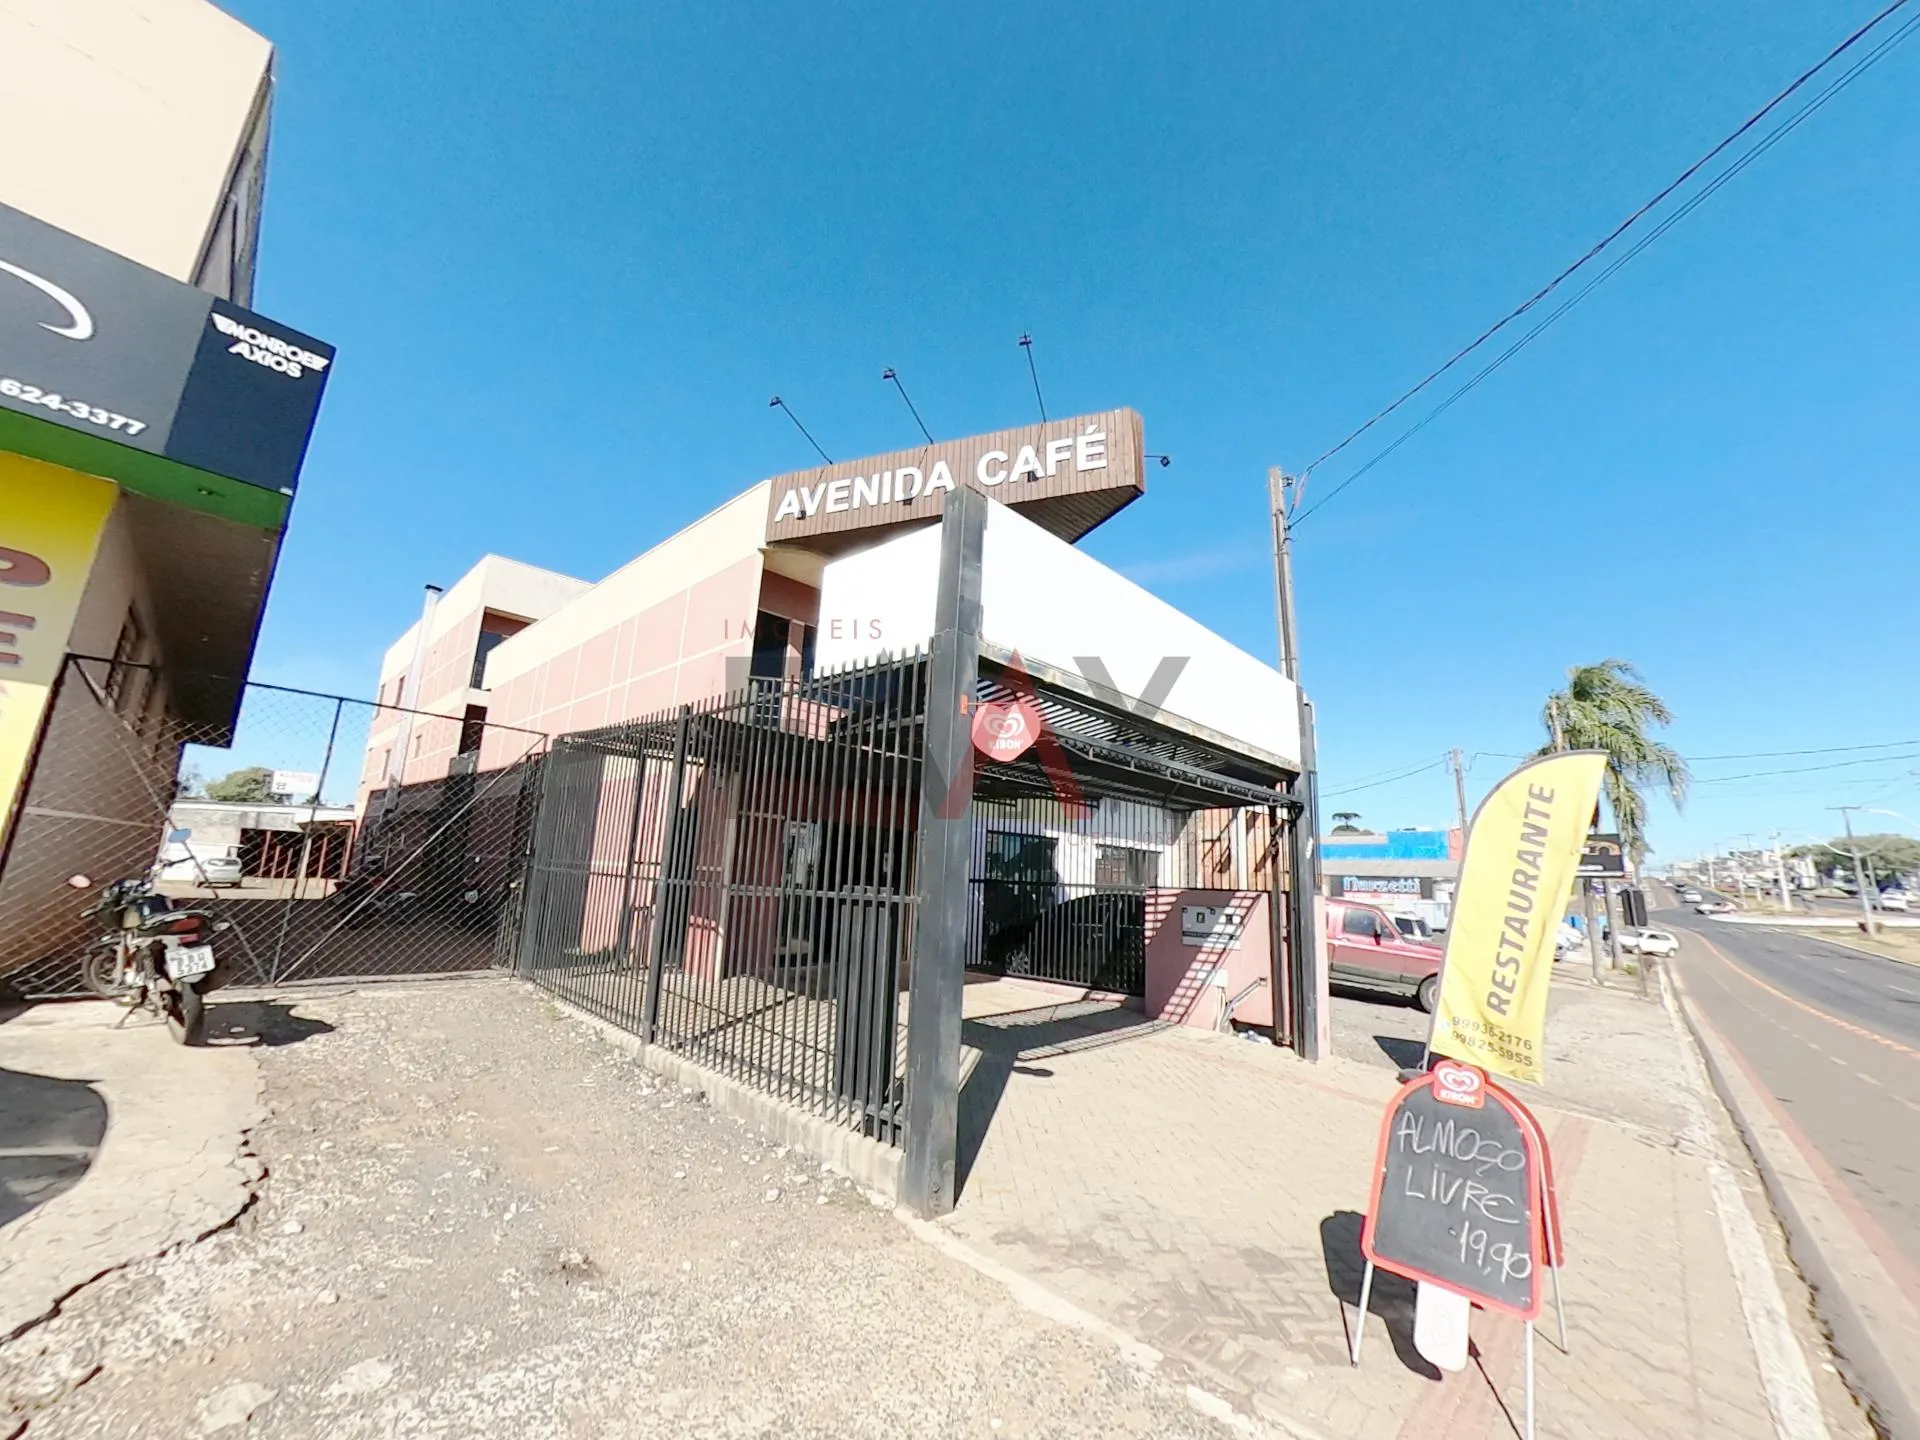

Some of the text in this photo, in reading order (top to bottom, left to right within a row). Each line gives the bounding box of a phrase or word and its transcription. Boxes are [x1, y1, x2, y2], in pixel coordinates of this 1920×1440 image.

[211, 312, 330, 371] MONROE
[228, 341, 304, 378] AXIOS
[0, 379, 147, 435] 624-3377
[774, 425, 1108, 522] AVENIDA CAFÉ
[1487, 782, 1555, 1016] RESTAURANTE
[1405, 1164, 1520, 1225] LIVRE
